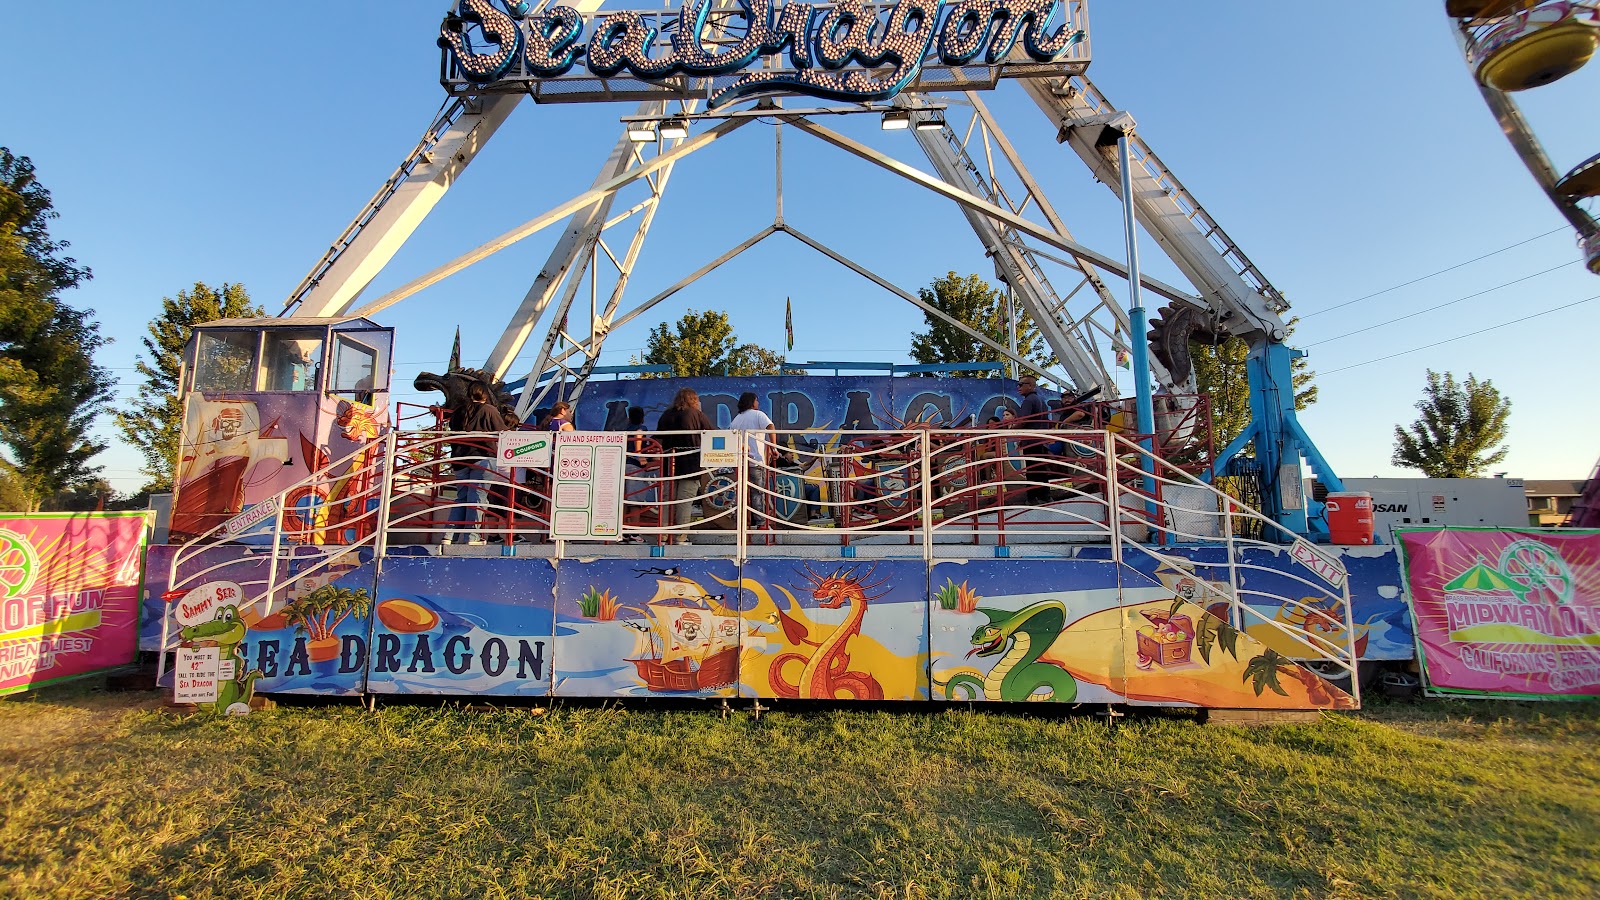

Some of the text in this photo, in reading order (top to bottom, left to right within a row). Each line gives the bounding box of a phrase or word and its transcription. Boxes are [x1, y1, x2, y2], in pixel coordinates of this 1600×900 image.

[506, 442, 544, 459] 6 COUPONS
[560, 435, 624, 443] FUN AND SAFETY GUIDE
[230, 502, 274, 532] ENTRANCE
[1294, 545, 1342, 581] EXIT
[3, 589, 105, 632] OF FUN
[182, 596, 213, 619] SAMMY
[1446, 602, 1555, 636] MIDWAY
[338, 633, 546, 681] DRAGON
[1462, 645, 1556, 673] CALIFORNIA'S
[179, 679, 213, 689] SEA DRAGON
